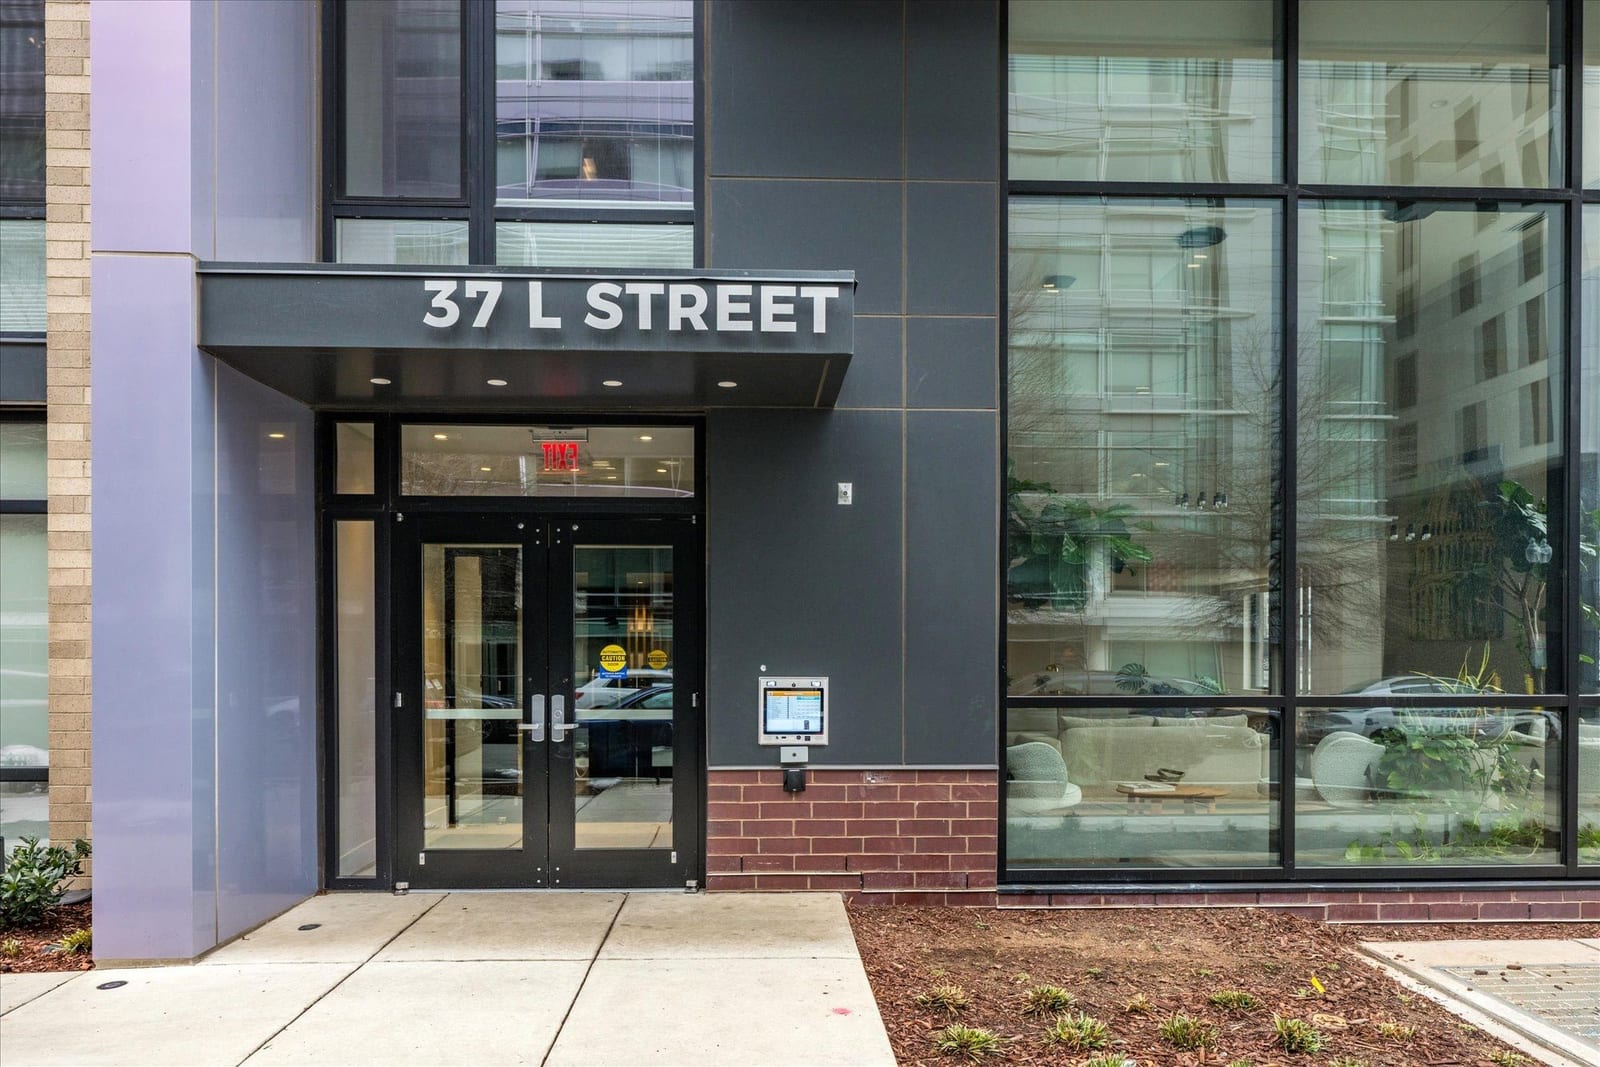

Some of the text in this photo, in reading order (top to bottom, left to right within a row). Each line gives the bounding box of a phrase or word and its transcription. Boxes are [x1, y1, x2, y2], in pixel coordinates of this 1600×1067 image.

[423, 280, 839, 334] 37 L STREET
